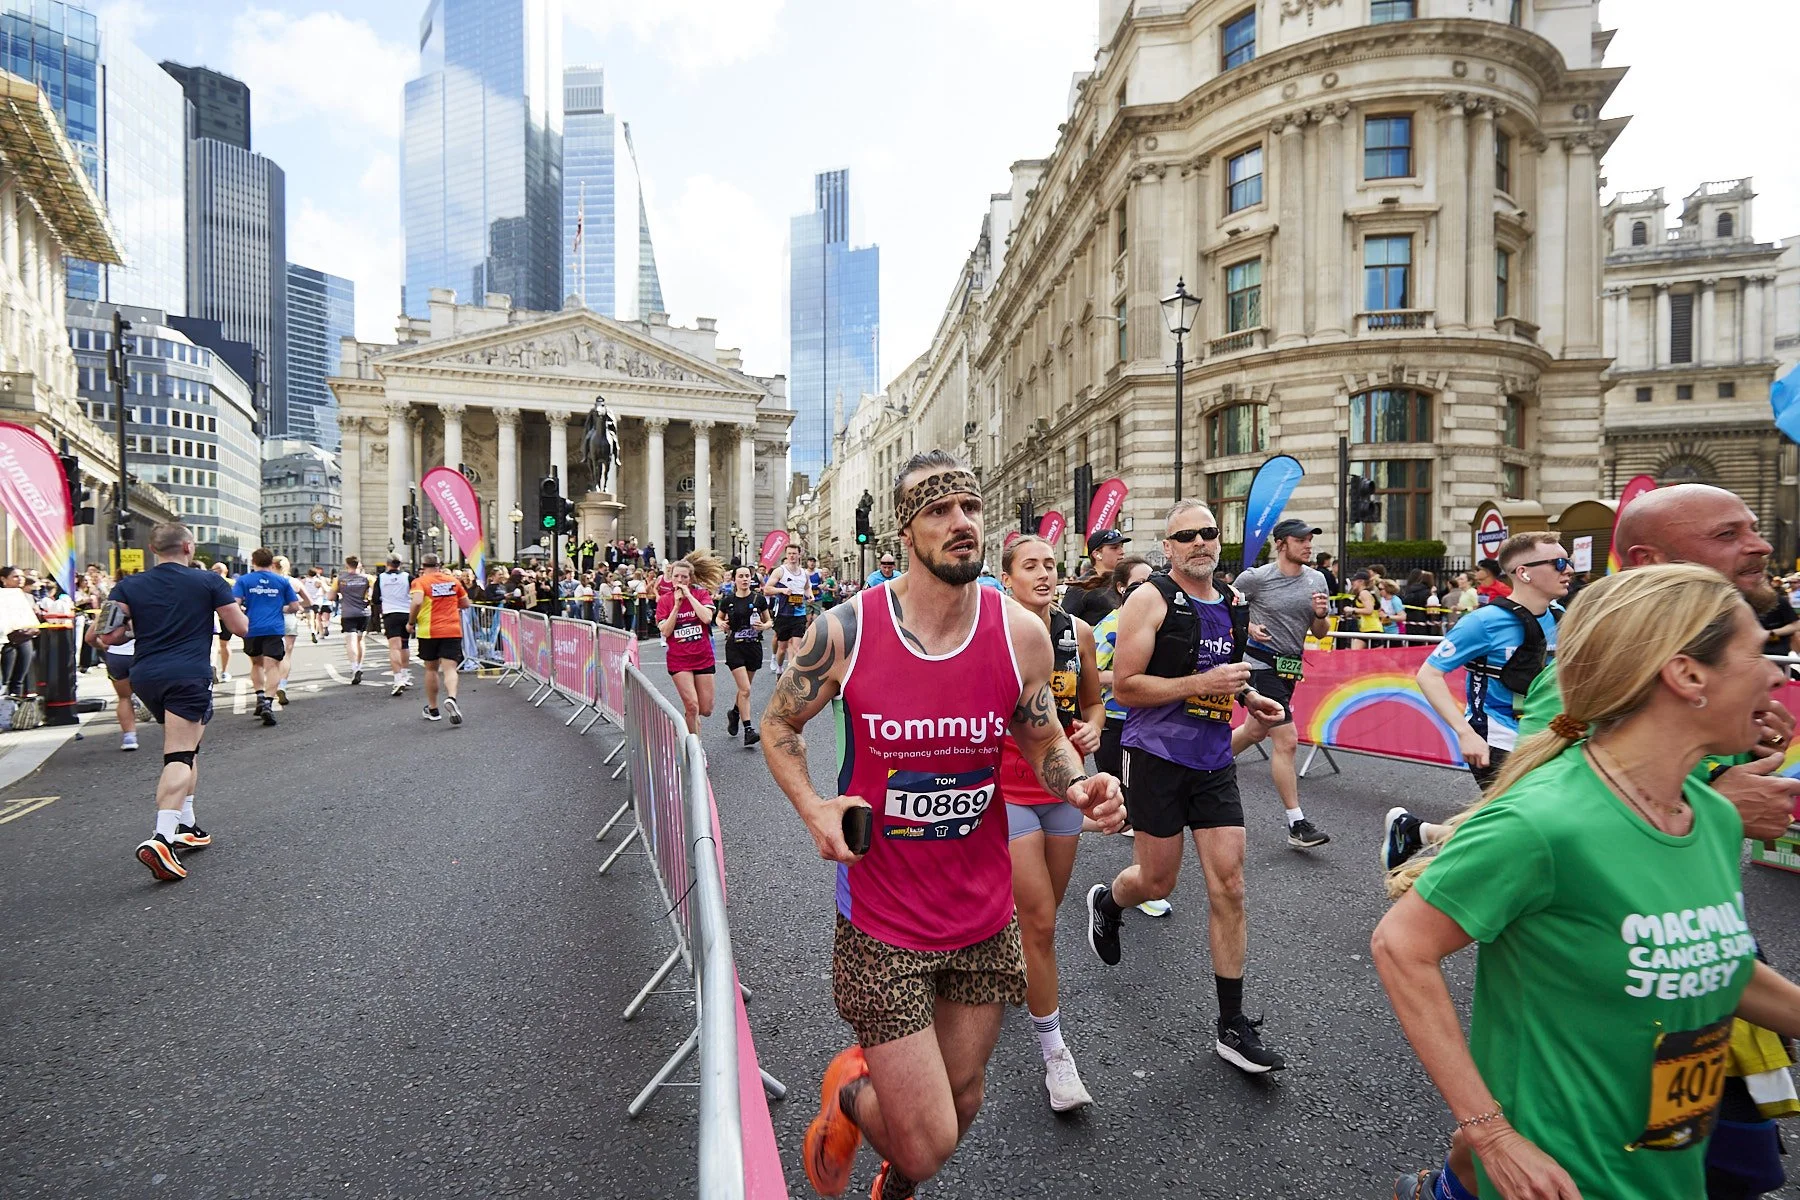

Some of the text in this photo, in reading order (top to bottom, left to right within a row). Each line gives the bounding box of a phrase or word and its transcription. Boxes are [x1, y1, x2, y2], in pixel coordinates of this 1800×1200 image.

[1045, 519, 1059, 542] mmy's
[764, 535, 783, 560] Tommy's
[676, 626, 701, 638] 10870
[1281, 660, 1302, 671] 8274
[1052, 675, 1065, 693] 5
[861, 711, 1004, 743] Tommy's
[869, 746, 882, 757] The
[883, 748, 932, 759] pregnancy
[933, 747, 951, 755] and
[953, 746, 976, 755] baby
[935, 777, 957, 785] TOM
[895, 789, 988, 818] 10869
[1628, 941, 1720, 969] CANCER
[1624, 960, 1740, 1000] JERSEY
